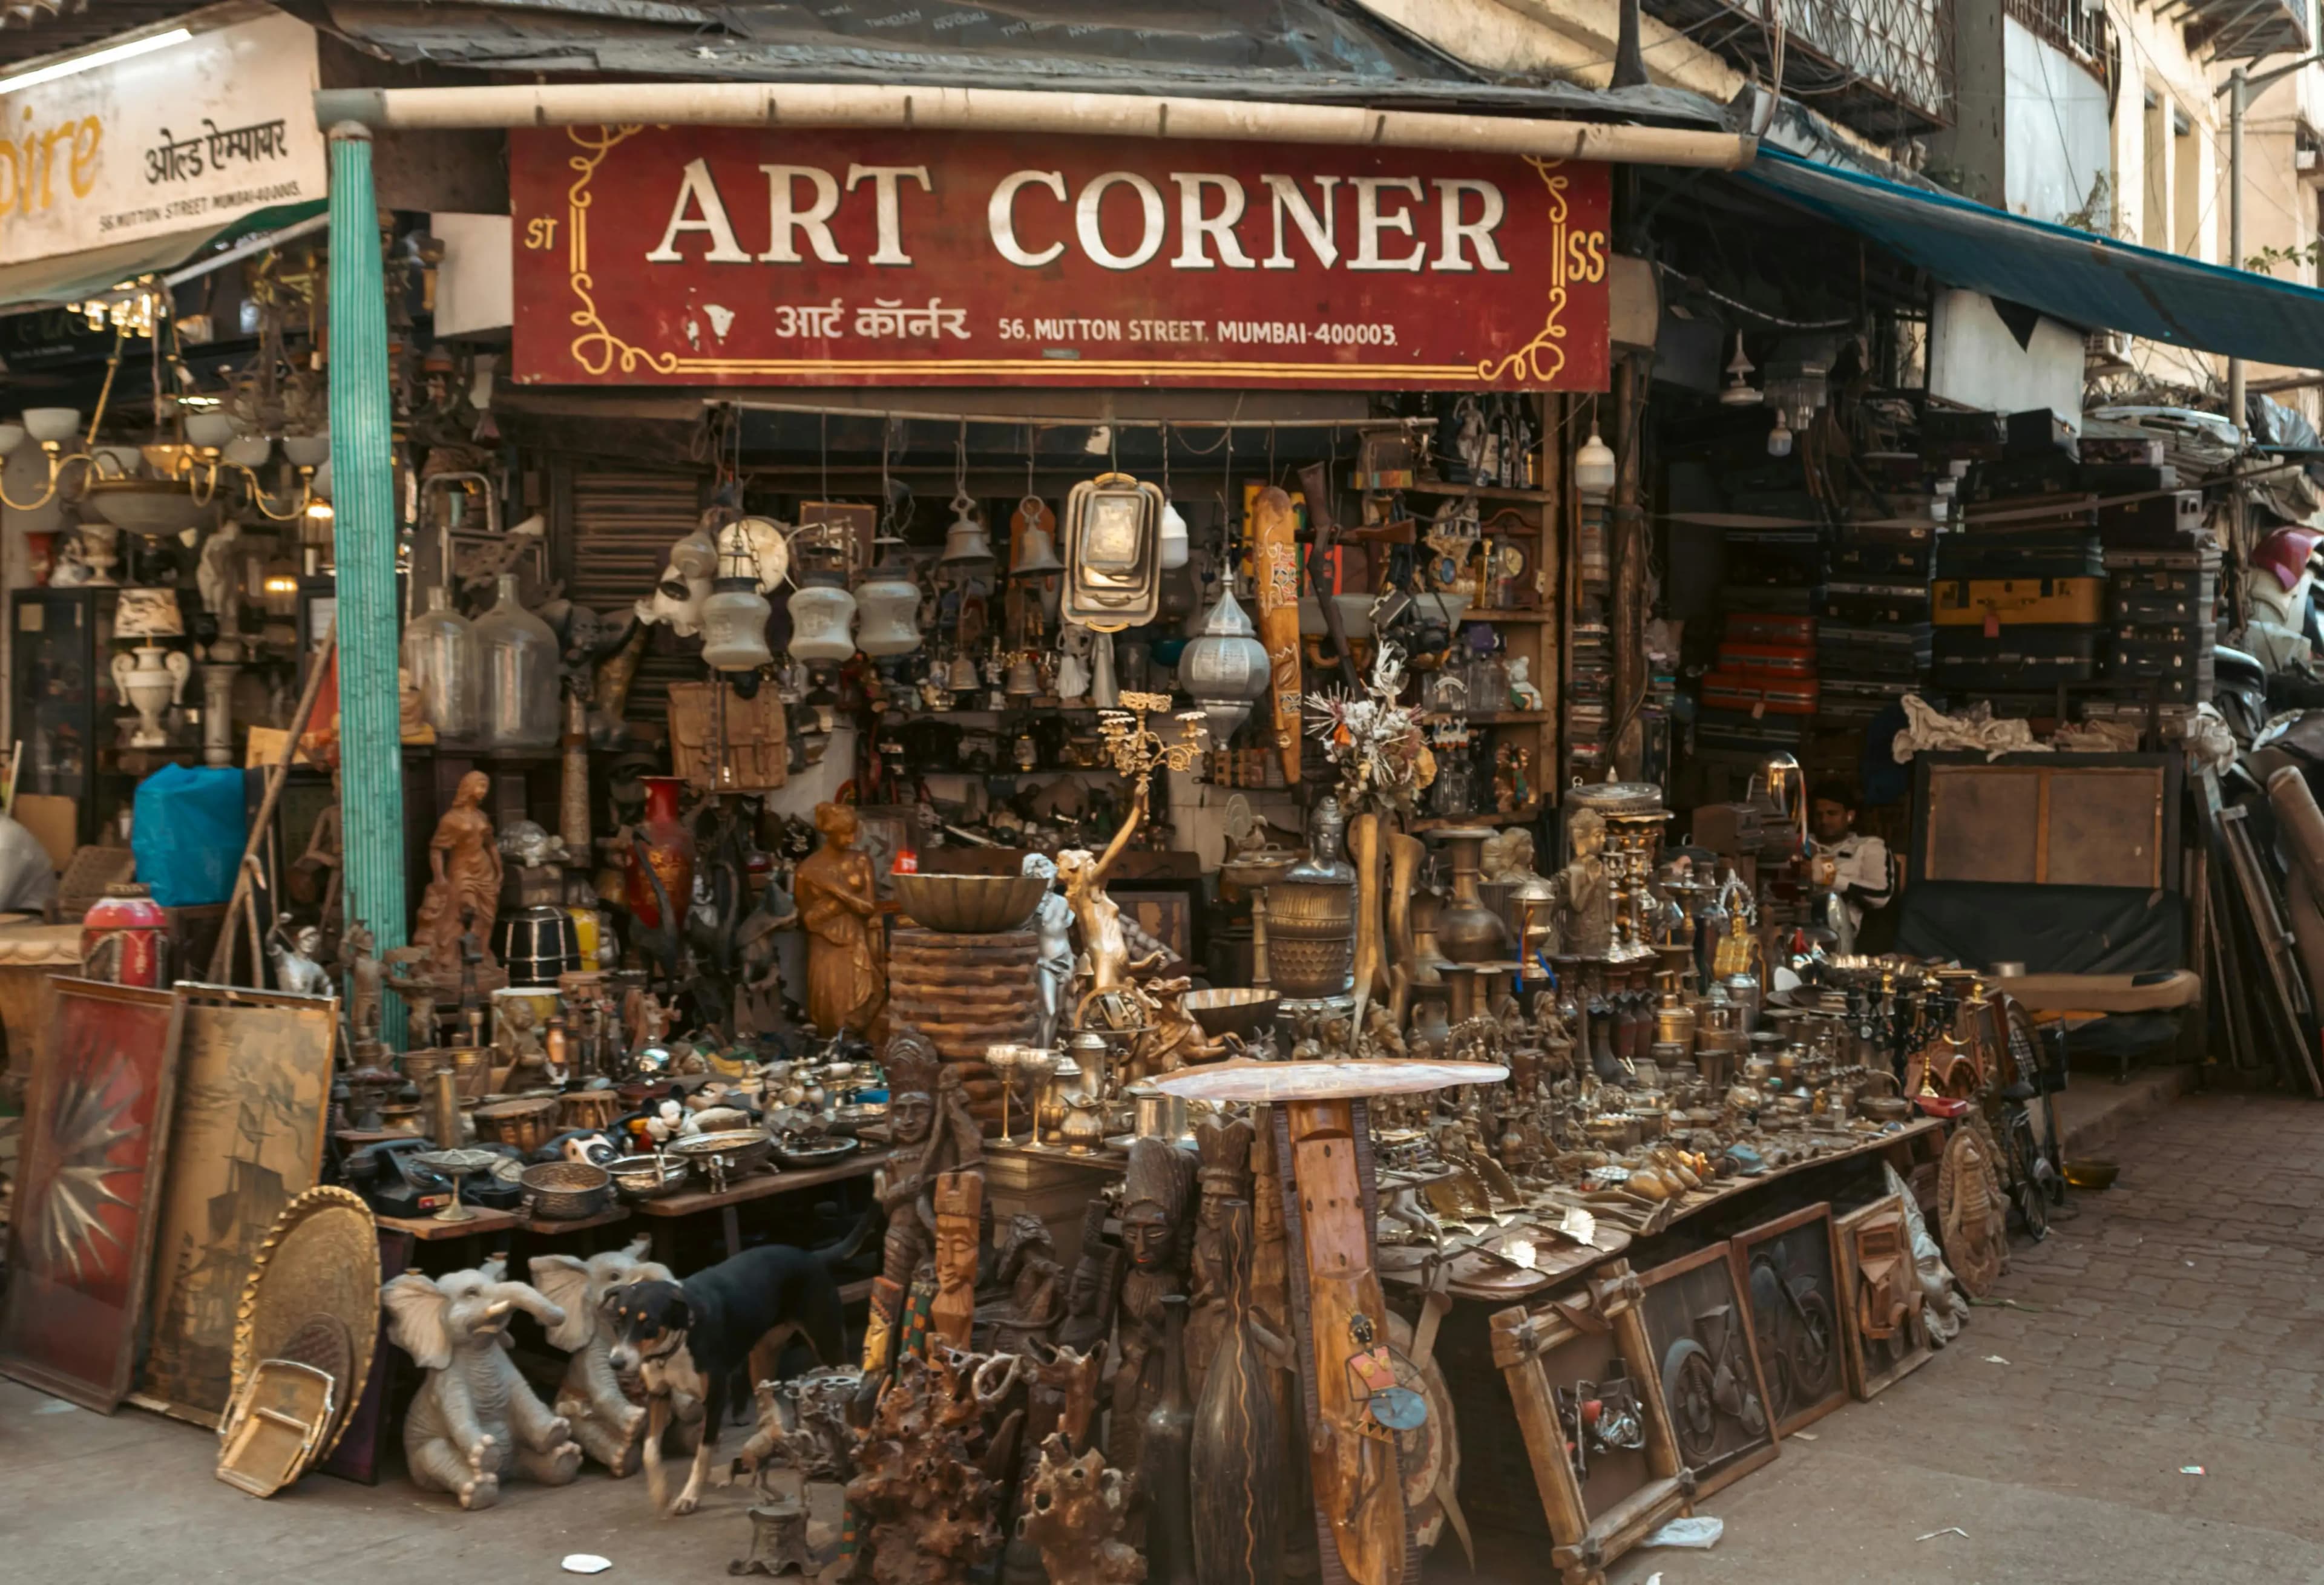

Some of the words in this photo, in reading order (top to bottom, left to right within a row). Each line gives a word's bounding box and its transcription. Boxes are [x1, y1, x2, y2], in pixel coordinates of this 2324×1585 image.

[145, 127, 204, 185] ओल्ड
[165, 197, 208, 219] STREET
[645, 157, 933, 266] ART
[988, 169, 1511, 272] CORNER
[524, 218, 559, 251] ST
[775, 297, 845, 339] आर्ट
[855, 297, 972, 340] कॉर्नर
[1033, 318, 1123, 341] MUTTON
